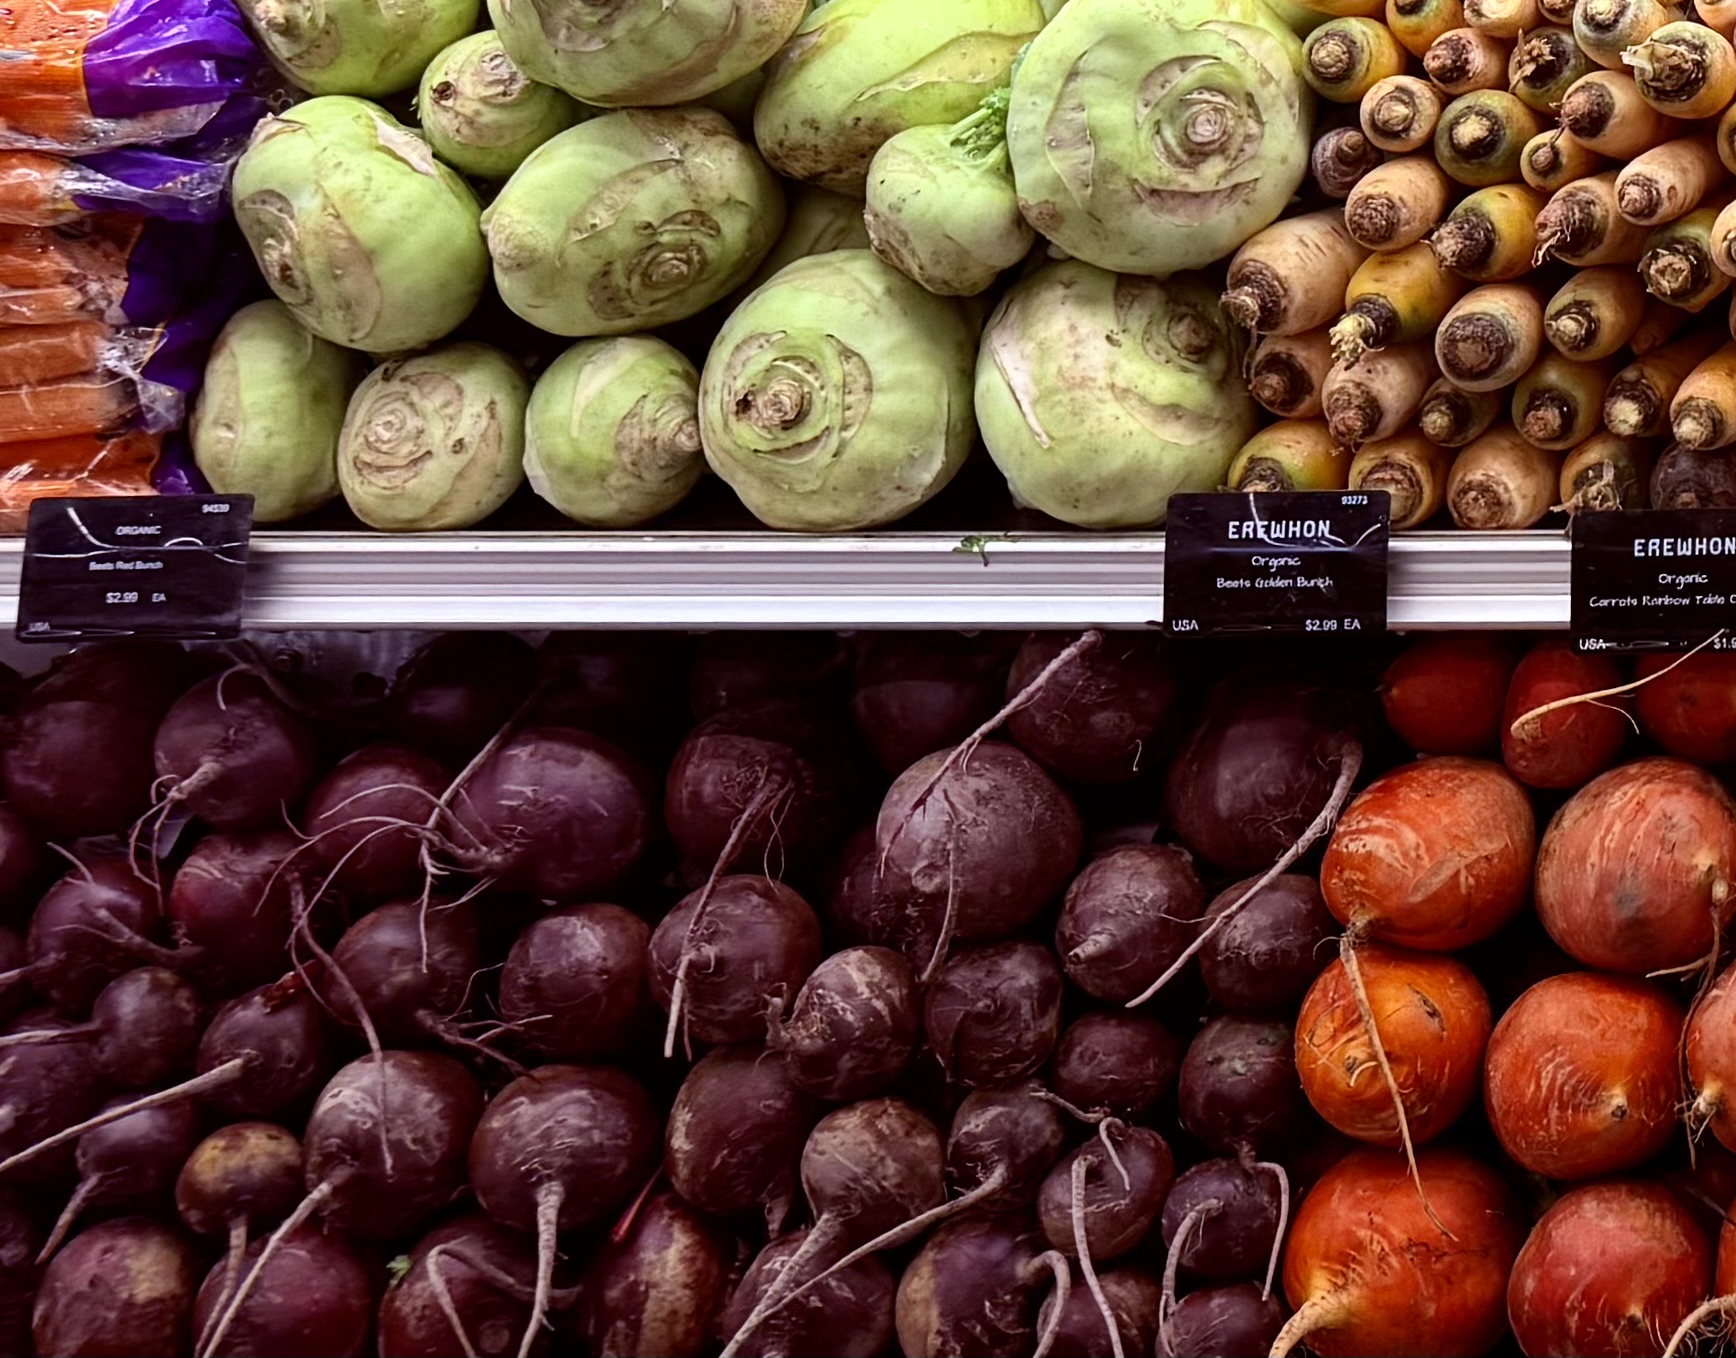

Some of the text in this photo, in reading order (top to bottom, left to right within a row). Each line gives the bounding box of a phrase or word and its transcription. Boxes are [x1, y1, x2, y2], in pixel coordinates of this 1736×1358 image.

[116, 526, 161, 535] ORGANIC
[1229, 520, 1330, 539] EREWHON
[1634, 537, 1735, 556] EREWHON
[1252, 556, 1301, 572] Organic
[1217, 577, 1333, 588] Beets Golden Bunch
[1659, 572, 1708, 589] Organic
[152, 593, 166, 602] EA
[1590, 596, 1637, 607] Carrots
[1642, 595, 1690, 606] Rainbow
[1172, 620, 1199, 630] USA
[1305, 619, 1360, 631] $2.99 EA
[1580, 639, 1606, 649] USA
